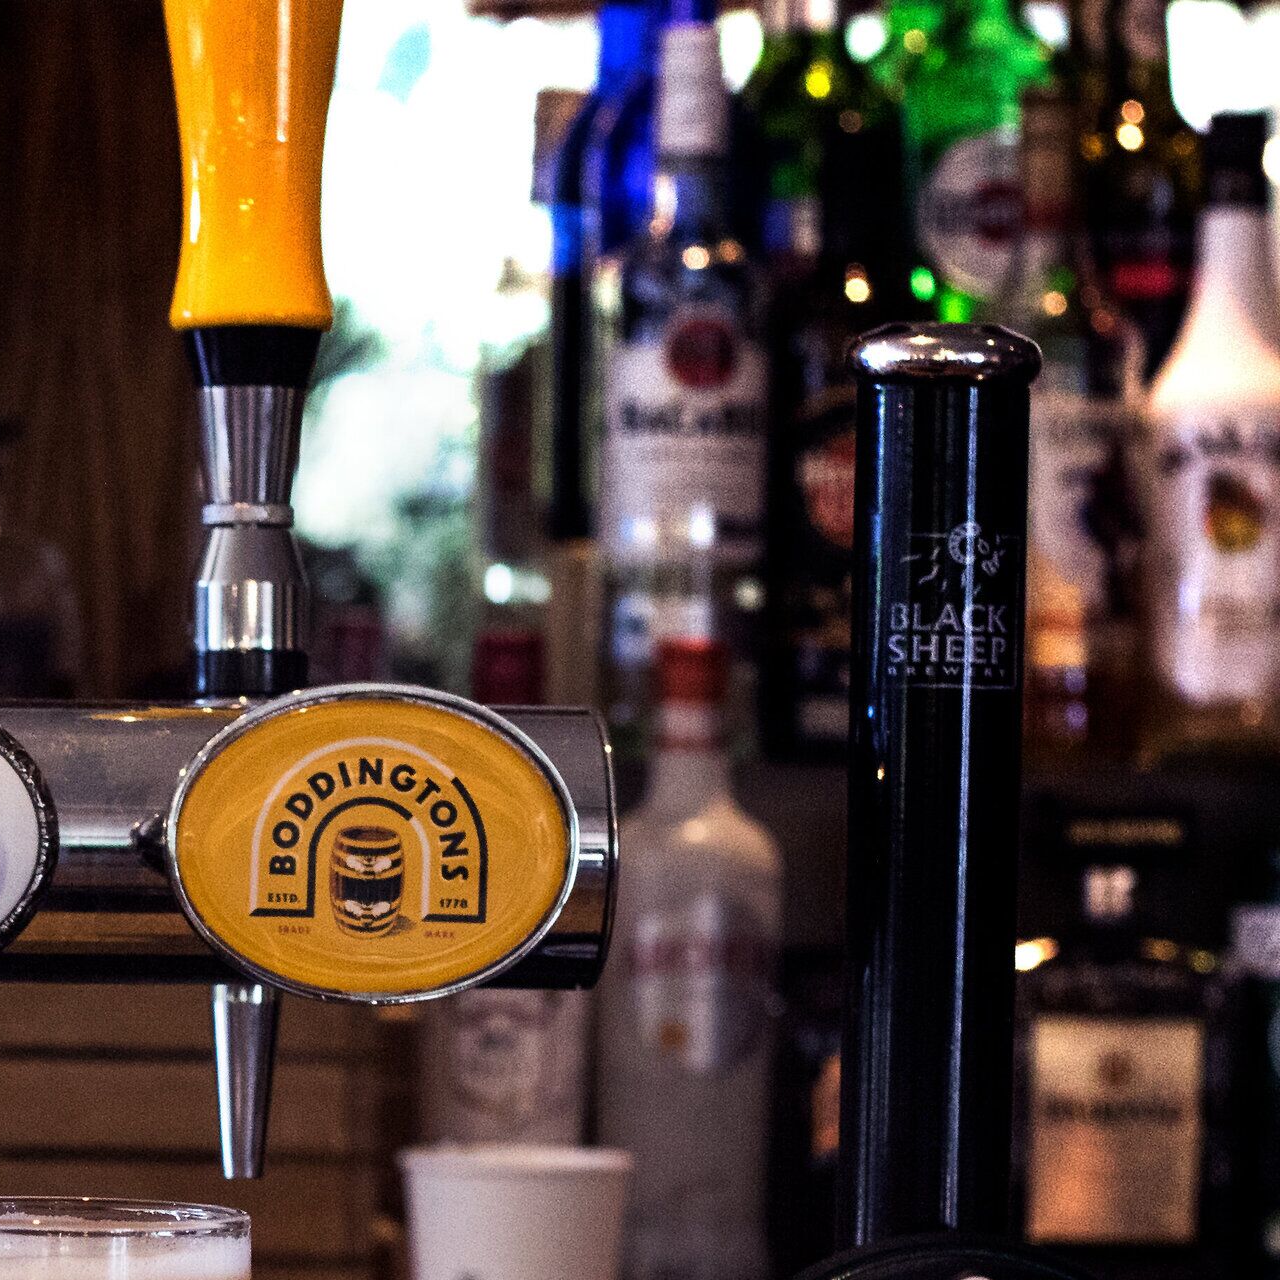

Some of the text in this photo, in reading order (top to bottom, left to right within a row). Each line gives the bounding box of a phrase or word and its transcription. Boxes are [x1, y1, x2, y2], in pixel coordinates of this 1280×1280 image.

[890, 602, 1007, 633] BLACK
[889, 634, 1007, 664] SHEEP
[270, 758, 468, 881] BODDINGTONS
[267, 892, 298, 903] ESTD
